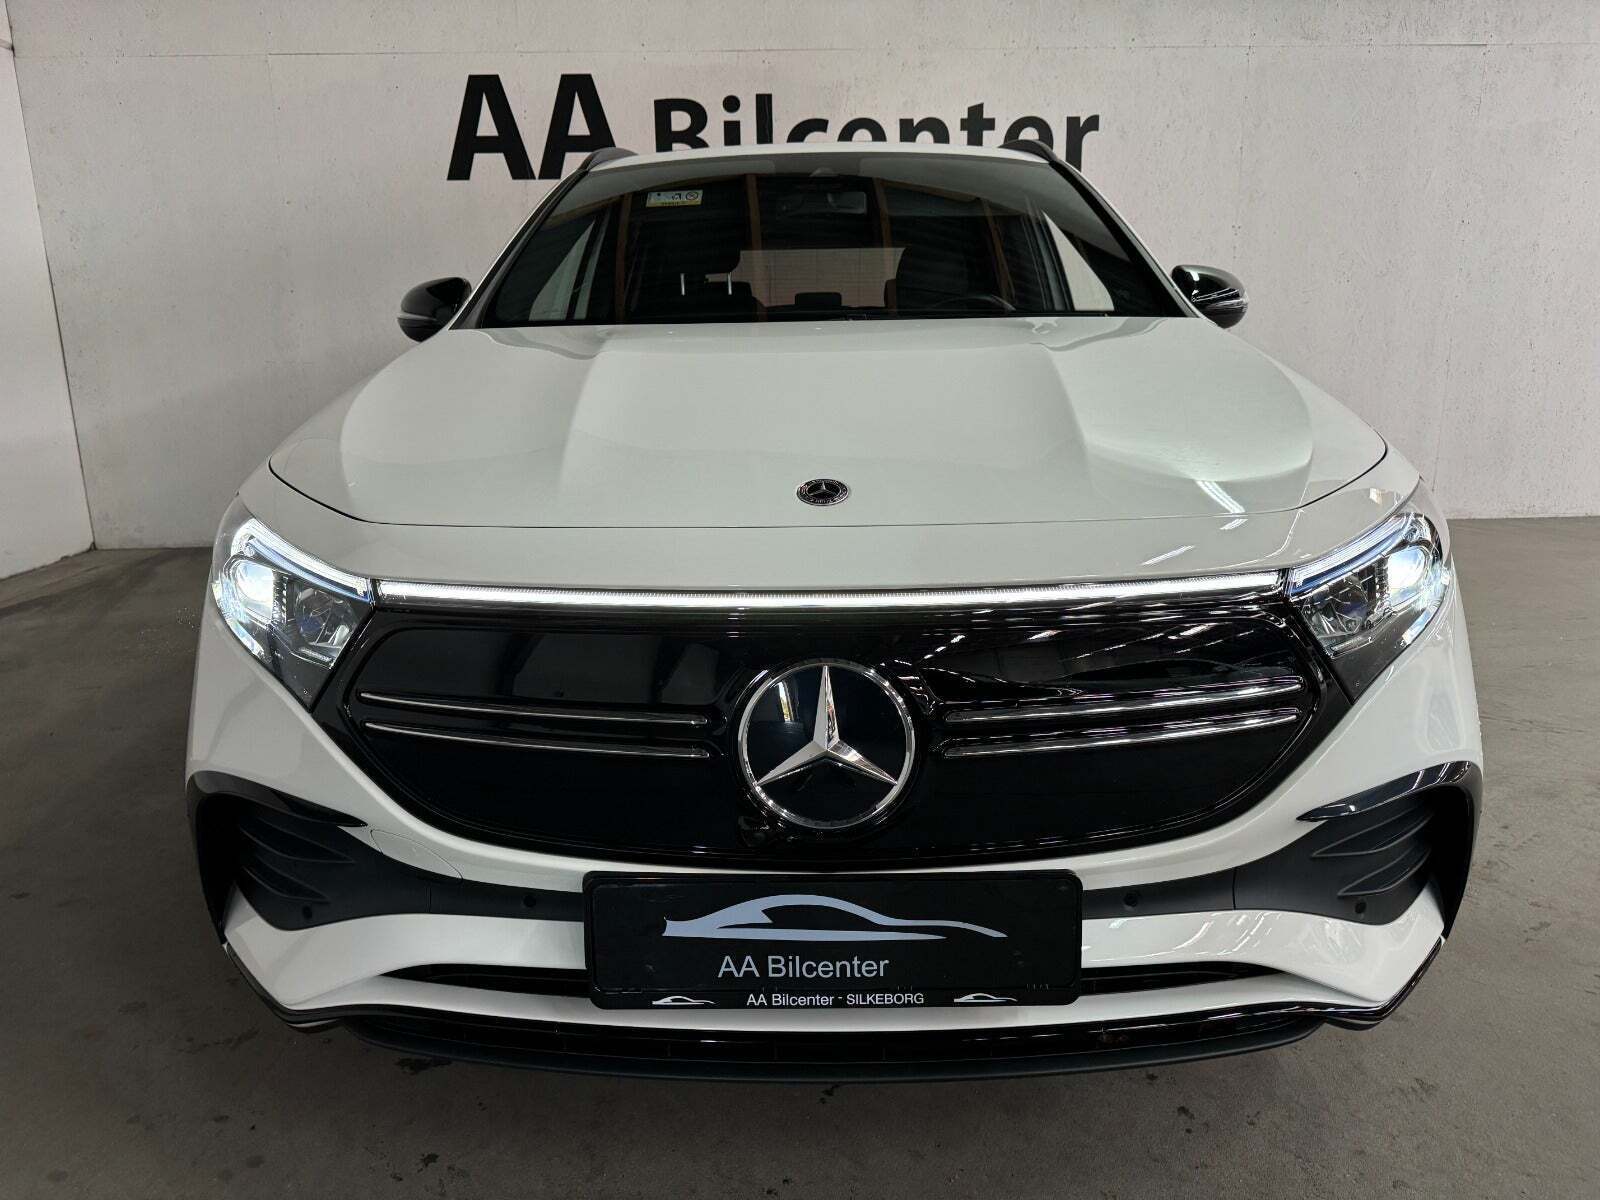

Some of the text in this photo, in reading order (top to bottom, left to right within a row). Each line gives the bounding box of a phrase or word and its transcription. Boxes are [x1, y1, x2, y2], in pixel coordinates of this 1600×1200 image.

[447, 74, 616, 181] AA
[717, 955, 890, 978] AA Bilcenter
[746, 993, 767, 1006] AA
[772, 993, 834, 1006] Bilcenter
[846, 993, 924, 1005] SILKEBORG
